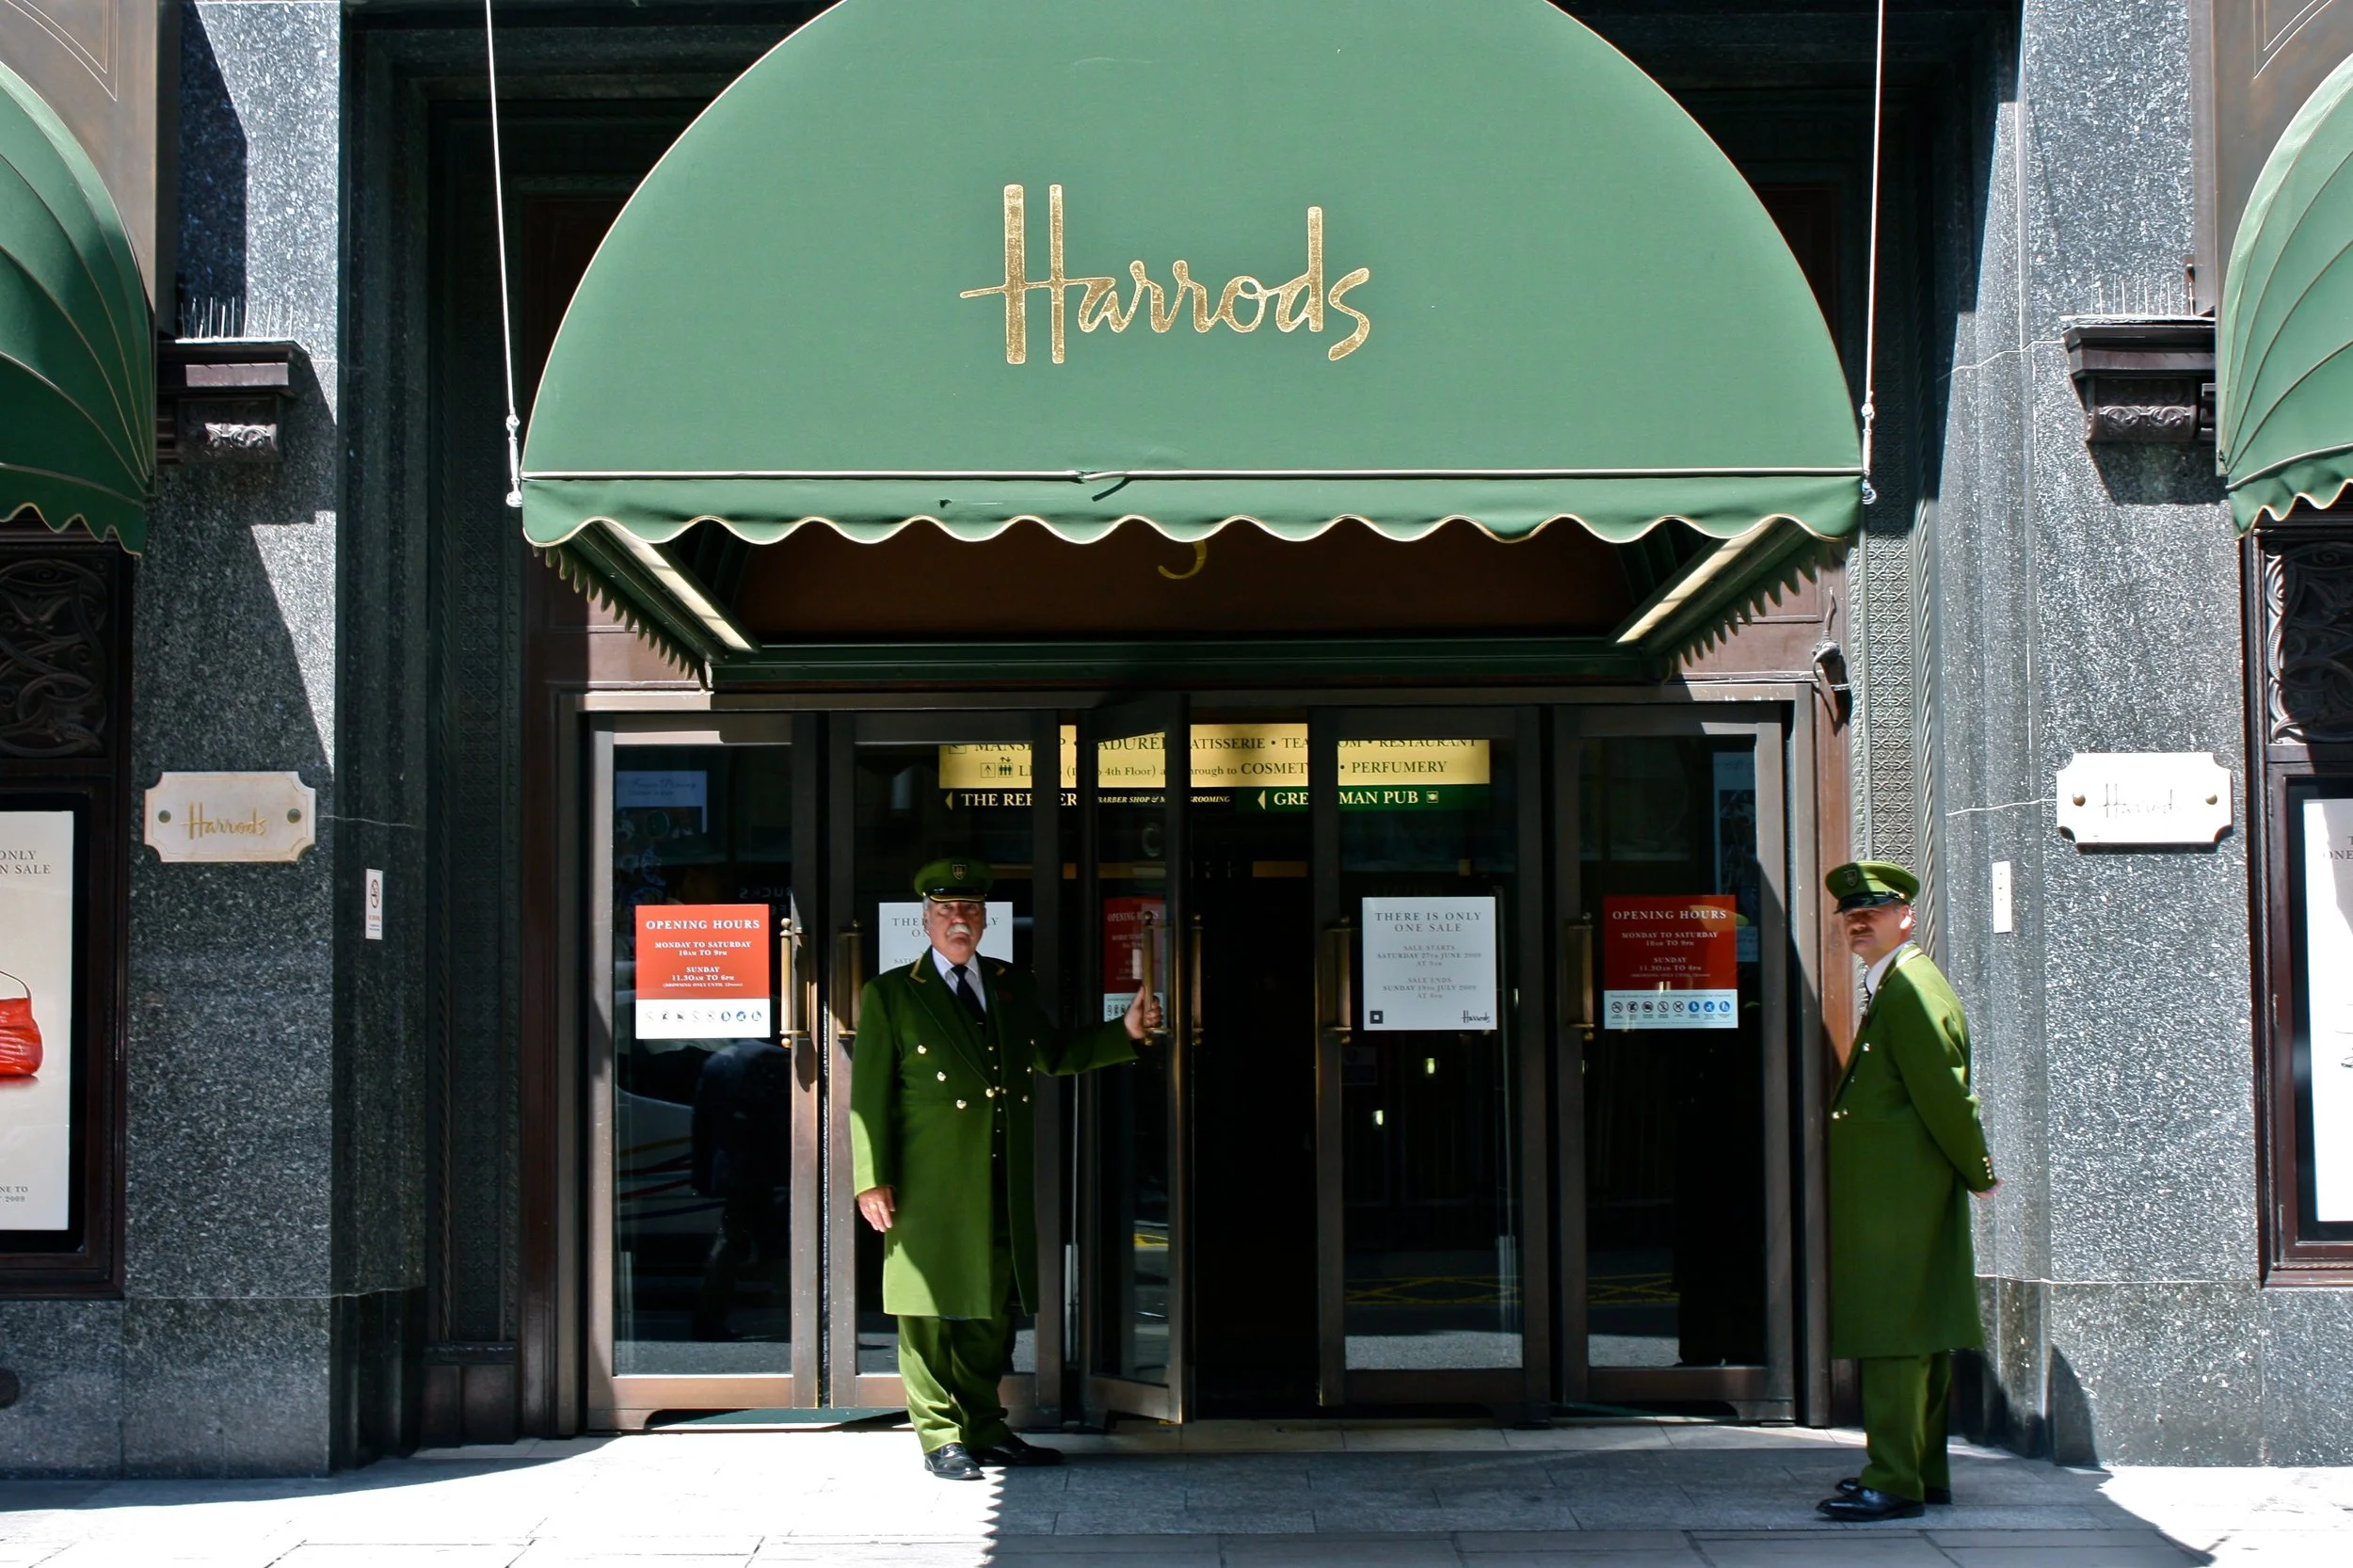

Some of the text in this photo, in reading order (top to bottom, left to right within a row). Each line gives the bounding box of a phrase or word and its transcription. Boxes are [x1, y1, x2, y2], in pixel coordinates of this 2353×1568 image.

[960, 184, 1369, 364] Harrods
[1191, 738, 1266, 749] ATISSERIE
[1103, 765, 1122, 776] 4th
[1226, 767, 1238, 776] to
[1241, 762, 1308, 775] COSMET
[1351, 760, 1448, 774] PERFUMERY
[960, 792, 999, 807] THE
[1128, 795, 1150, 804] SHOP
[1338, 792, 1378, 805] MAN
[1384, 791, 1419, 804] PUB
[181, 801, 267, 840] Harrods
[15, 864, 51, 874] SALE
[1375, 911, 1481, 921] THERE IS ONLY
[1612, 909, 1727, 920] OPENING HOURS
[646, 919, 760, 930] OPENING HOURS
[1395, 923, 1463, 933] ONE SALE
[14, 1185, 29, 1193] TO
